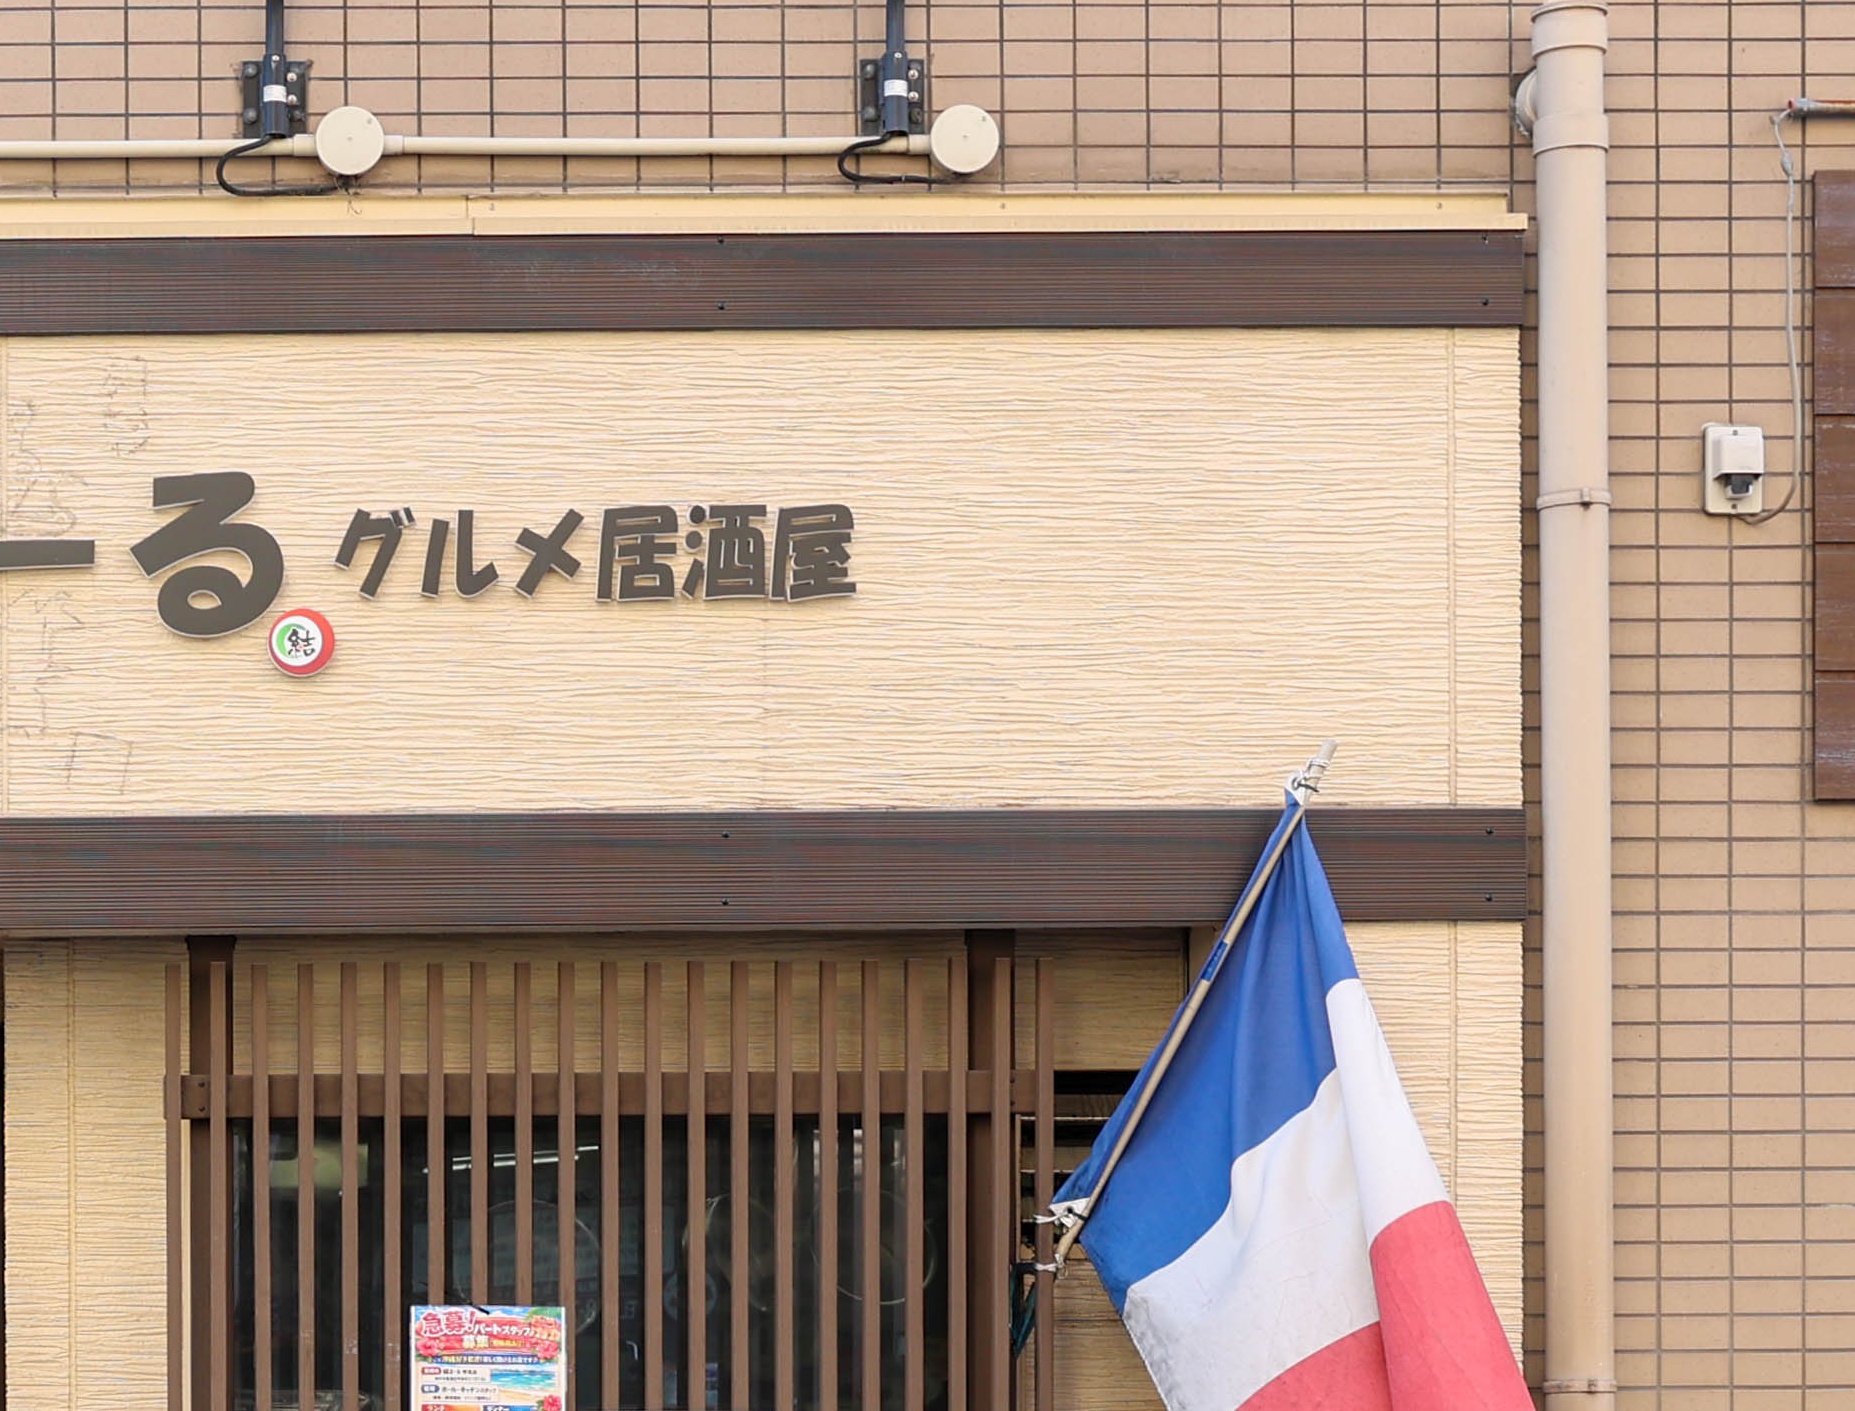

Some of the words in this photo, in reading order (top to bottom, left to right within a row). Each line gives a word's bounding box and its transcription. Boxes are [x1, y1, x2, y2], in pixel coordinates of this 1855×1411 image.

[334, 503, 857, 603] グルメ居酒屋
